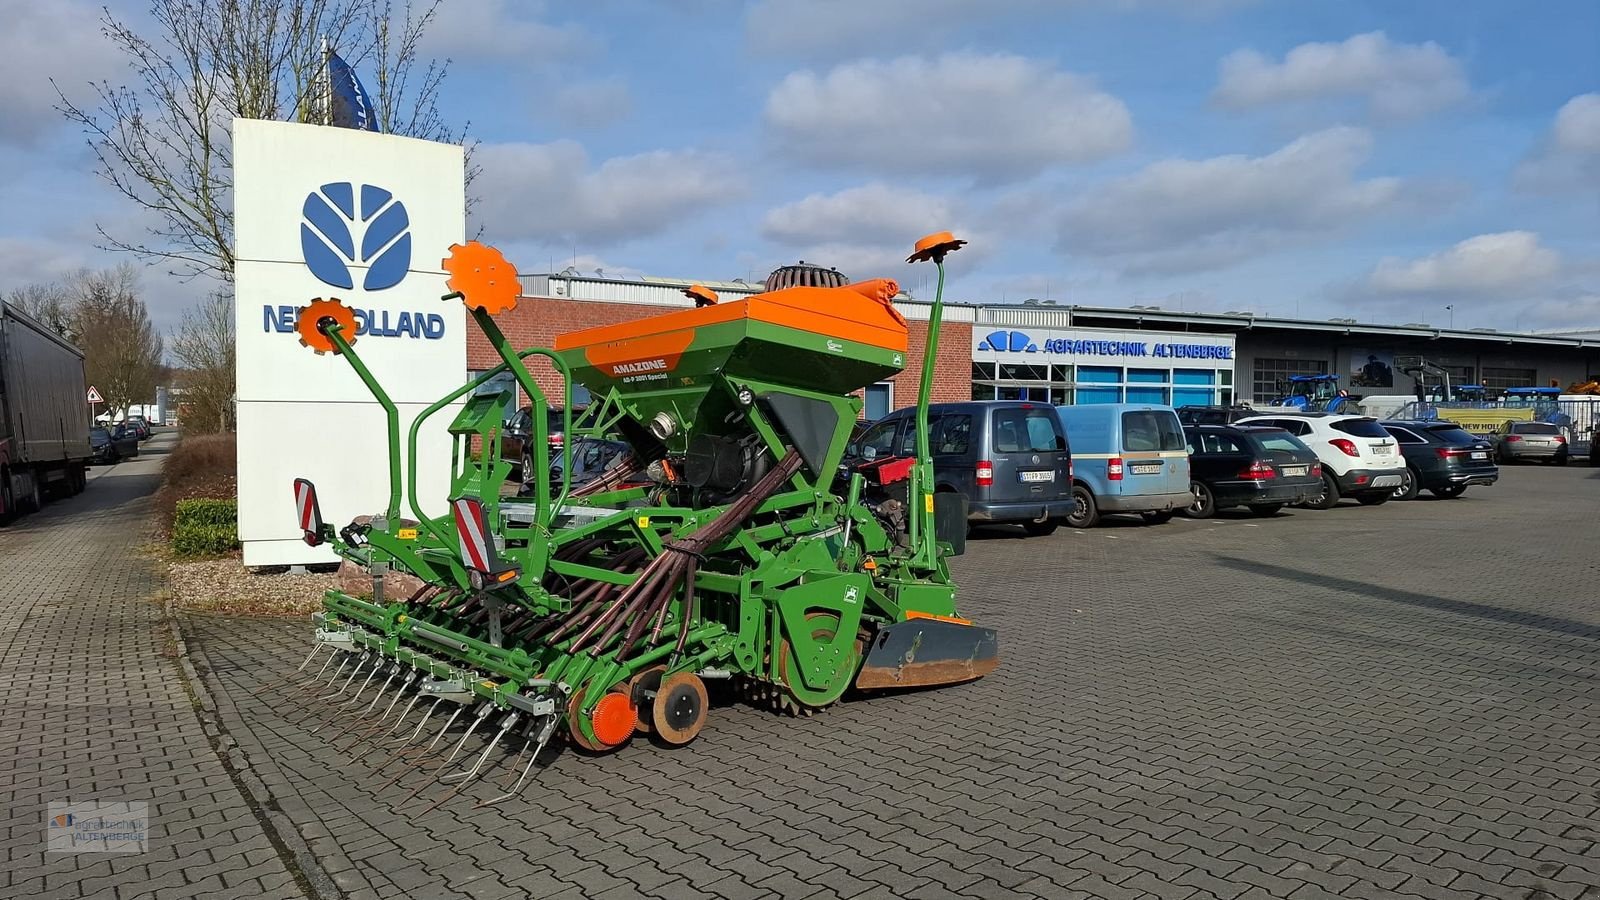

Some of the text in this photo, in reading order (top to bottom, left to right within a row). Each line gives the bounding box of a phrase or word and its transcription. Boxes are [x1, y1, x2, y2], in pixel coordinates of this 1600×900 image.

[263, 305, 446, 340] NE OLLAND
[1044, 338, 1234, 360] AGRARTECHNIK ALTENBERGE
[612, 359, 667, 374] AMAZONE
[648, 372, 668, 380] Special
